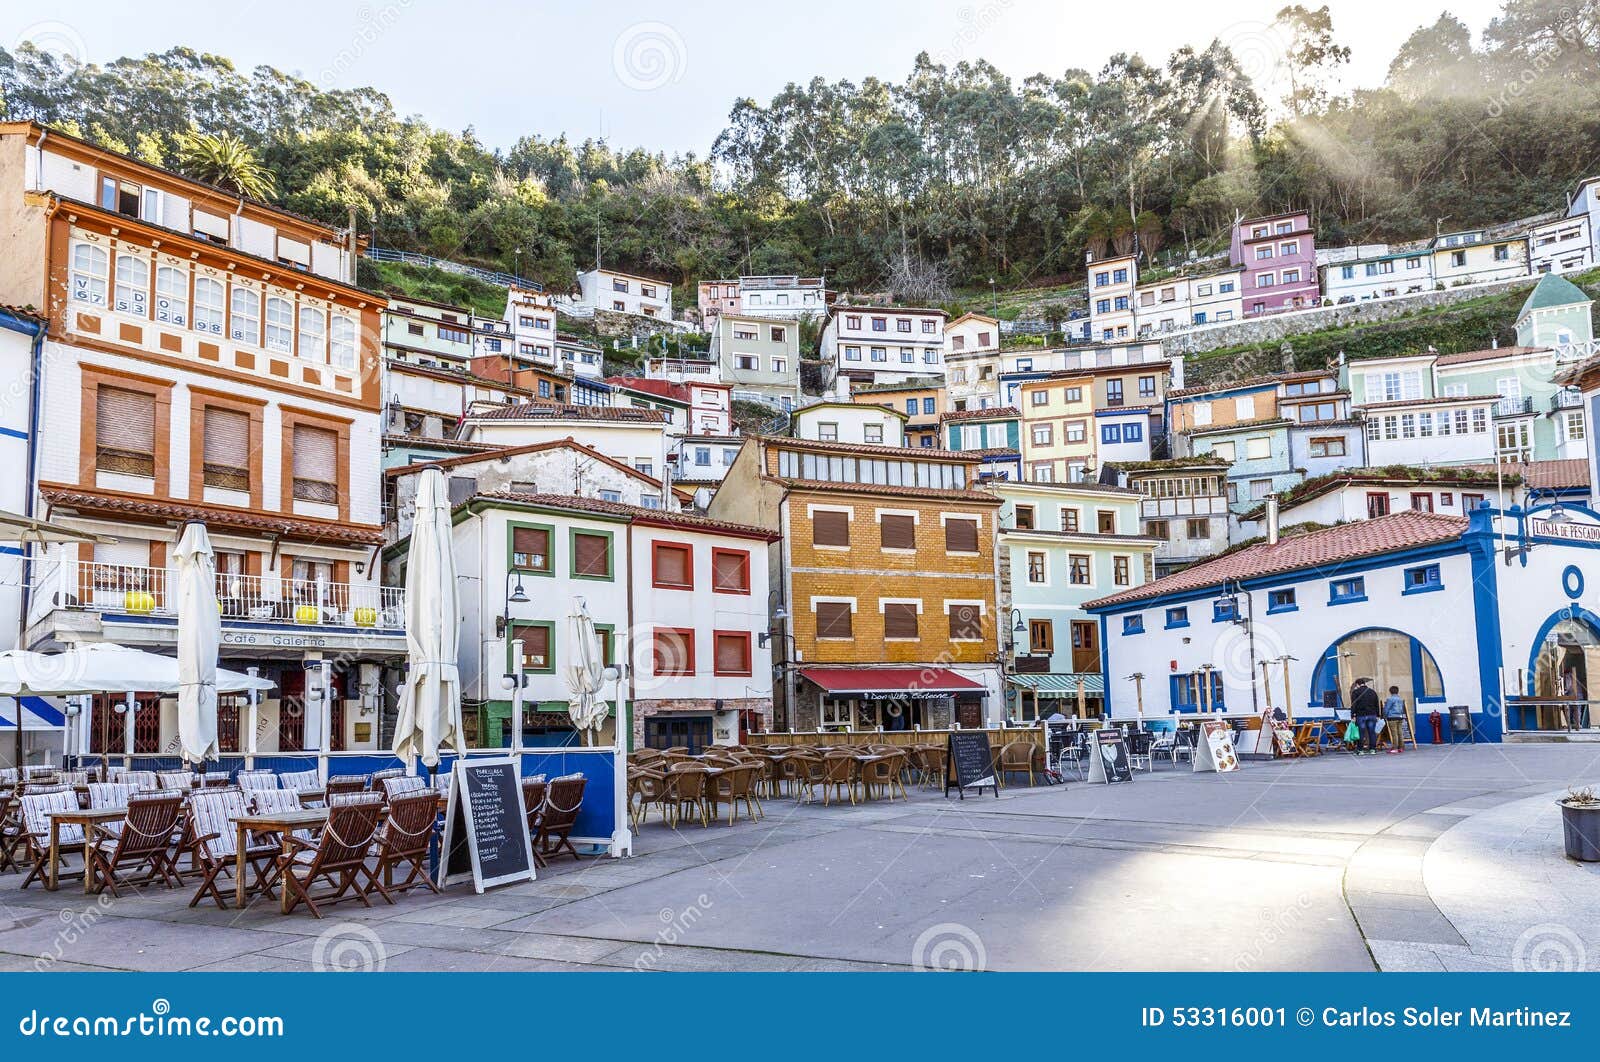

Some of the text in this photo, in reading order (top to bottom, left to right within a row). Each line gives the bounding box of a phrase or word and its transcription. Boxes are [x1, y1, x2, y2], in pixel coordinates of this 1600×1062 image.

[1536, 522, 1559, 536] LONJA
[1560, 526, 1569, 537] DE
[223, 633, 326, 647] Café Galerna
[870, 692, 887, 700] Don
